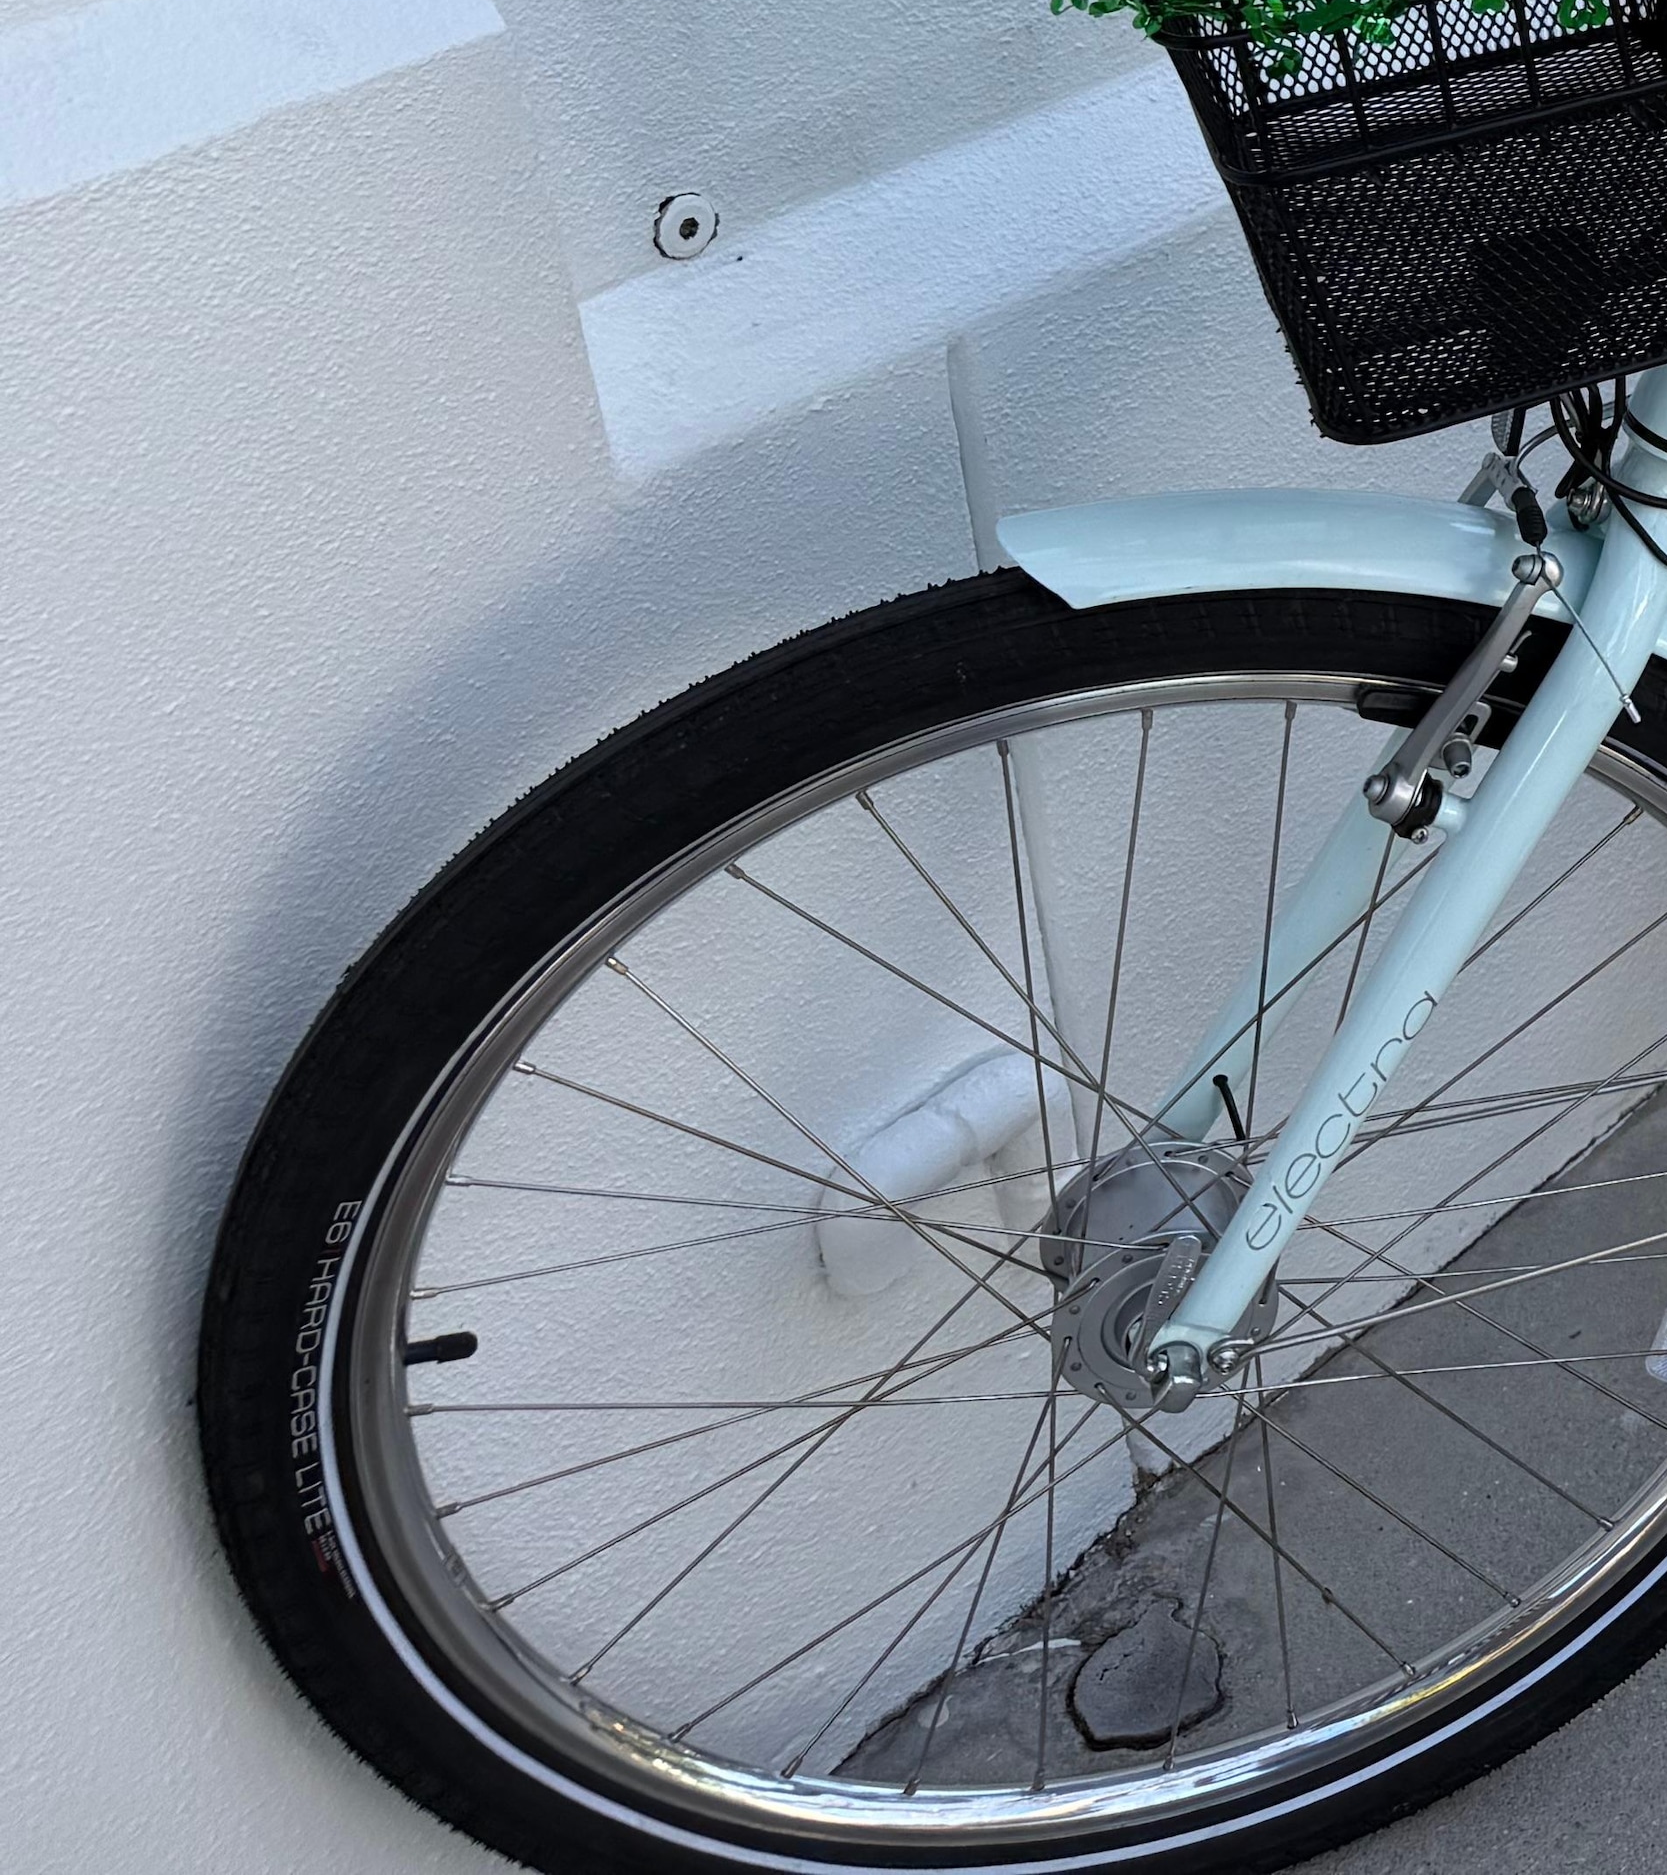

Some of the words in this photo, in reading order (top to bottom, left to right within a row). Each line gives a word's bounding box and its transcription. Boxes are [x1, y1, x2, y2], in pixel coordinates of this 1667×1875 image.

[1245, 989, 1438, 1251] electra
[291, 1256, 341, 1459] HARD-CASE
[296, 1461, 332, 1534] LITE
